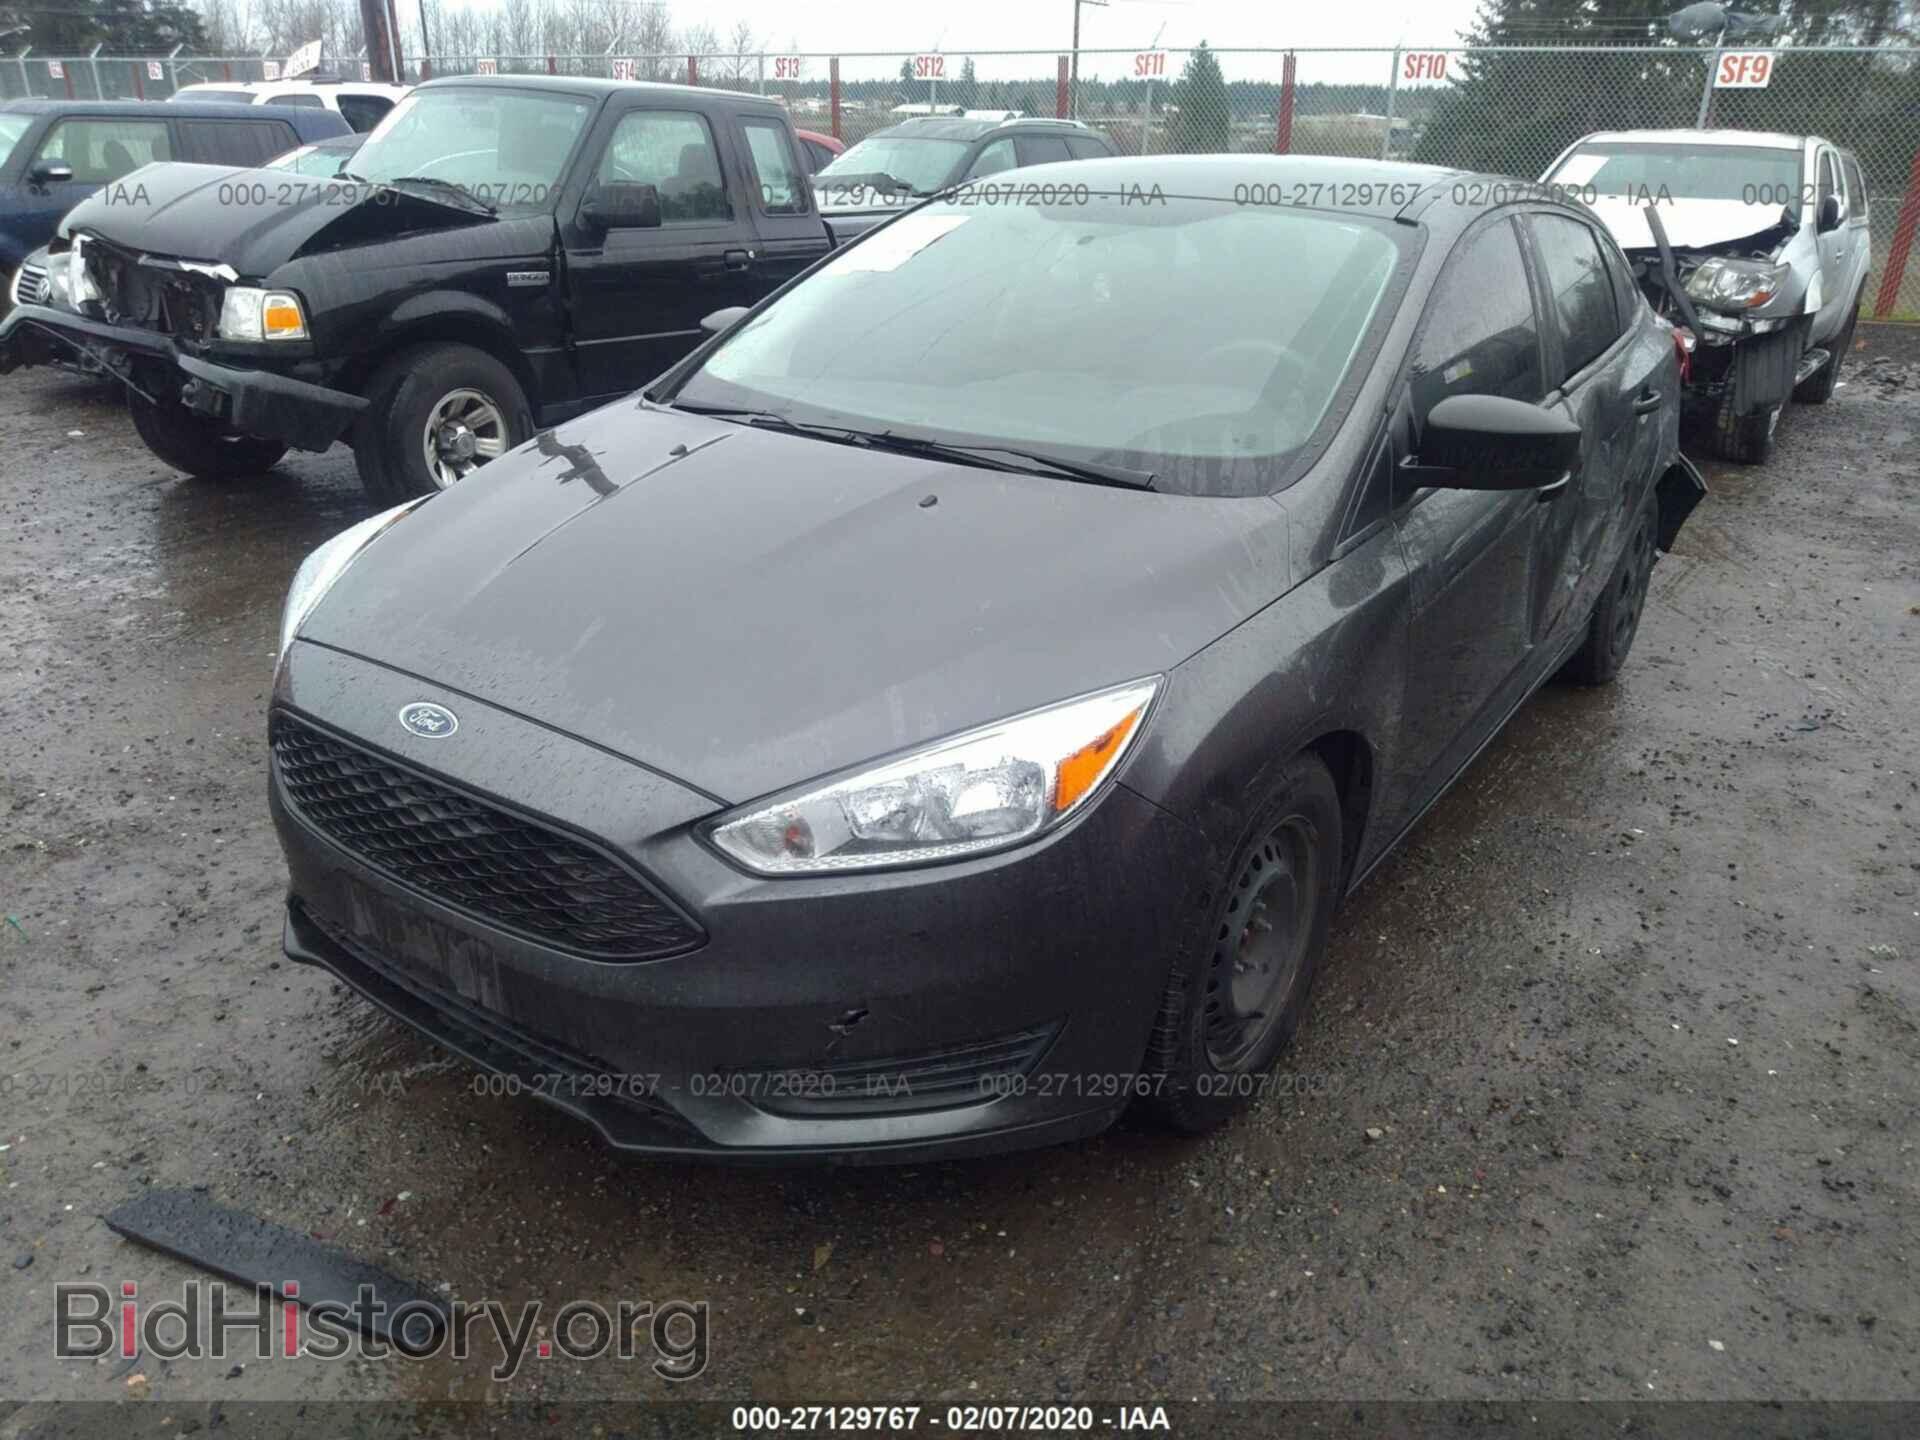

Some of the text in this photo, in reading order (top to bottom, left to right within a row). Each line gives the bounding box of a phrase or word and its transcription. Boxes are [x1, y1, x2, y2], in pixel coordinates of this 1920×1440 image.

[775, 57, 800, 78] SF13
[916, 56, 945, 77] SF12
[1134, 53, 1165, 76] SF11
[1404, 53, 1447, 79] SF10
[1719, 55, 1769, 84] SF9
